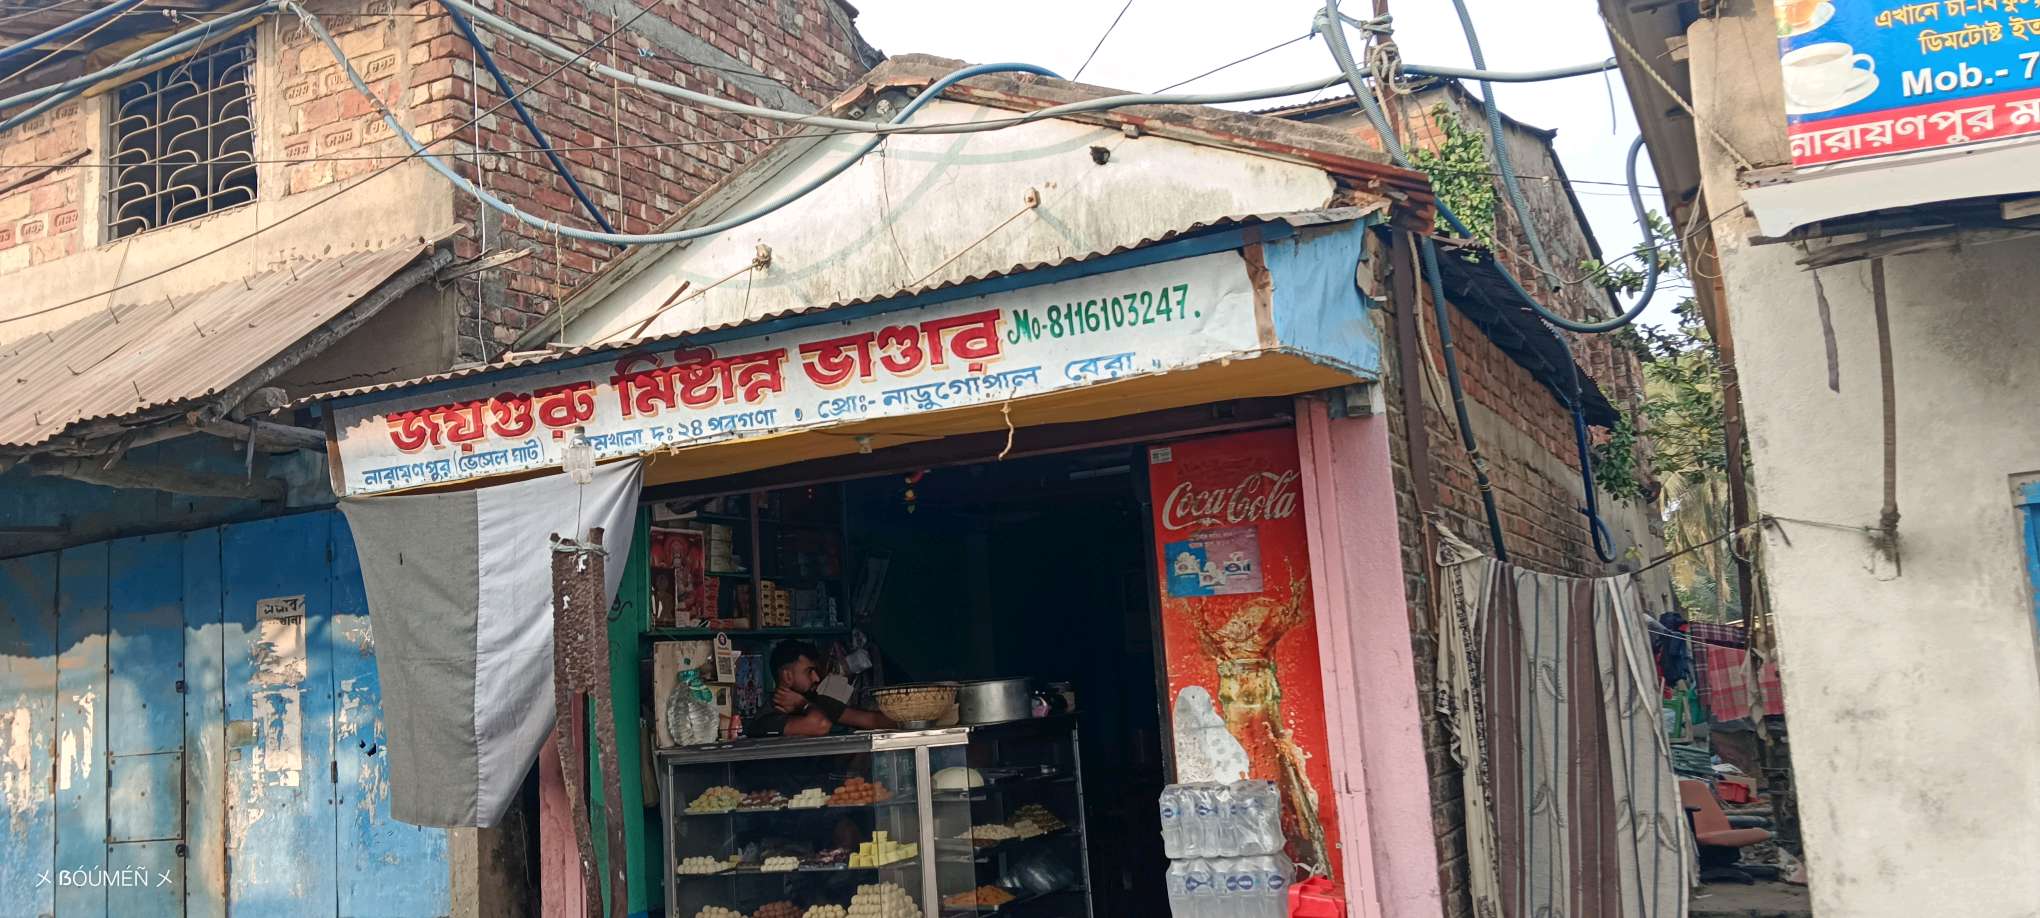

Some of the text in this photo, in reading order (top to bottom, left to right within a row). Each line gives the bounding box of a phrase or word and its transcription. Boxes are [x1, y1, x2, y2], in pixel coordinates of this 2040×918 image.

[1875, 2, 1940, 28] এখানে
[1902, 50, 2040, 97] Mob.- 7
[1788, 105, 1997, 157] নারায়ণপুর
[386, 381, 597, 454] জয়গুরু
[609, 341, 789, 422] মিষ্টান্ন
[799, 309, 1003, 390] ভাণ্ডার
[678, 419, 704, 437] ২৪
[1162, 469, 1299, 530] Coca-Cola
